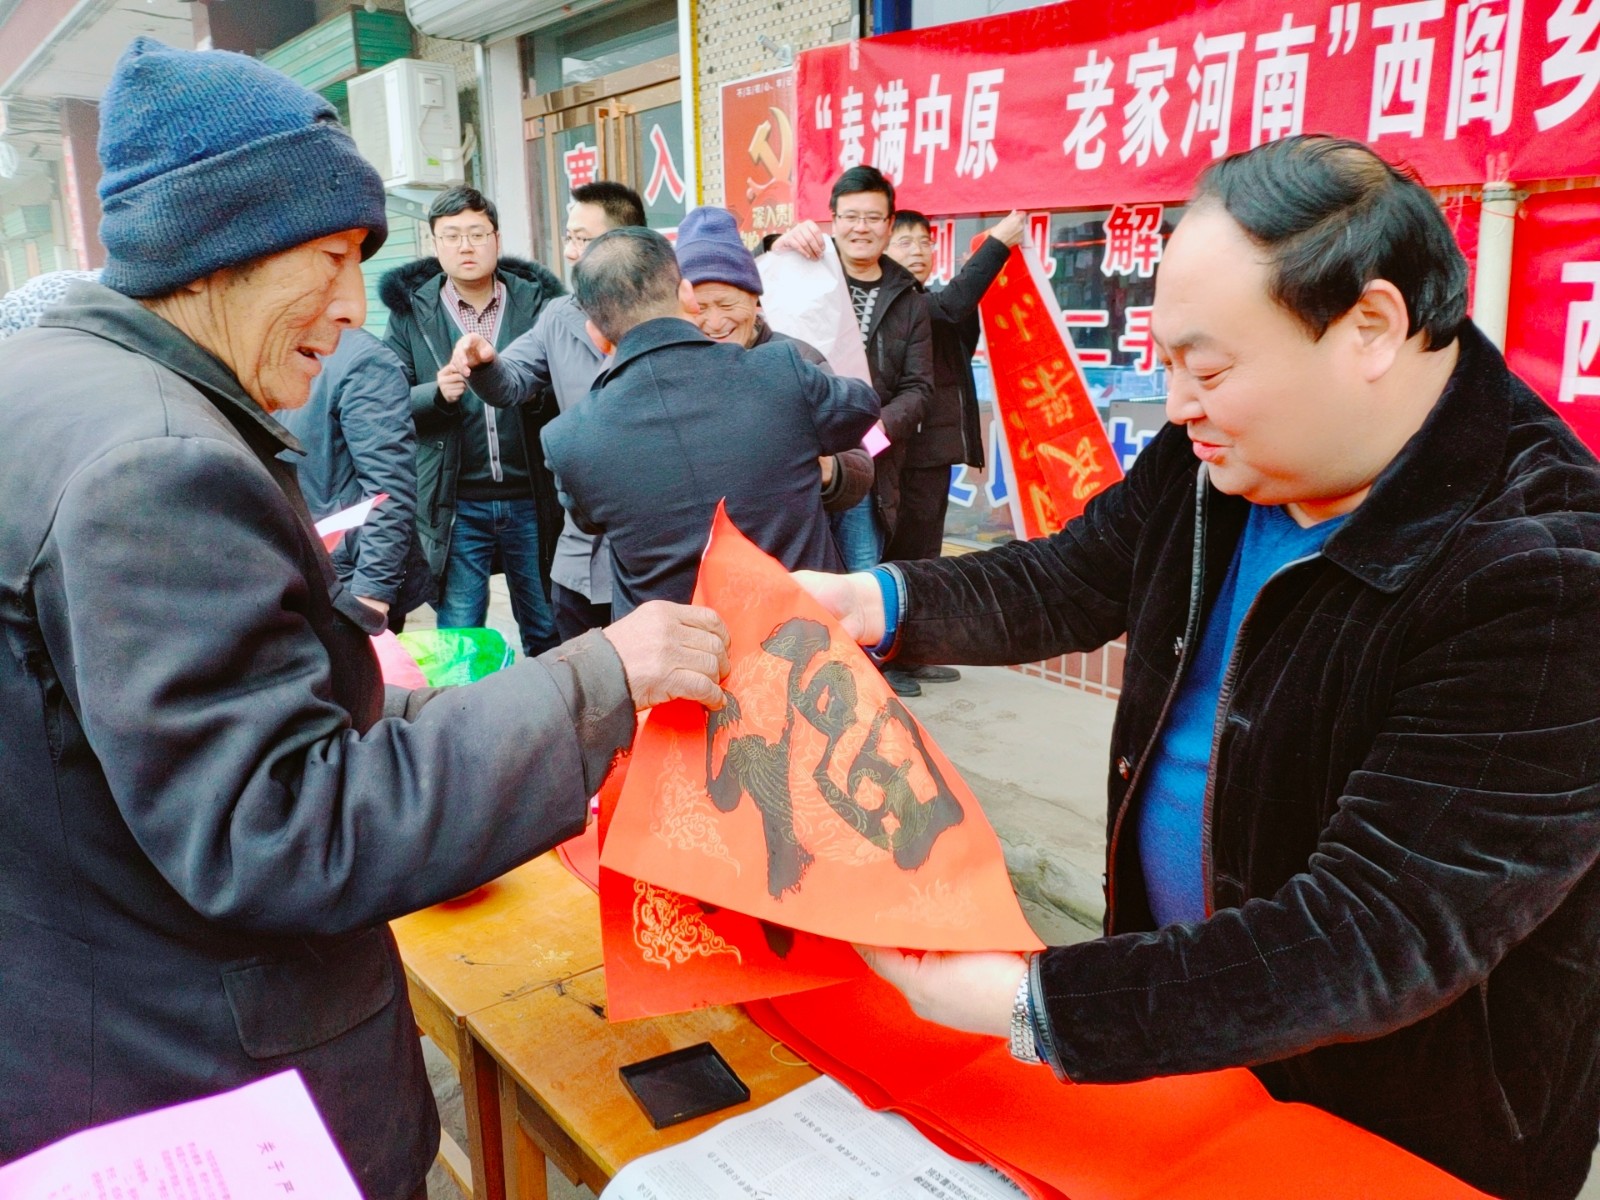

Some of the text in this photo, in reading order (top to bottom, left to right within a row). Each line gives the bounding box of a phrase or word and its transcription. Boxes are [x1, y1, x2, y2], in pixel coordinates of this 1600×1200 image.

[815, 68, 1004, 188] “春满中原
[706, 616, 966, 902] 福
